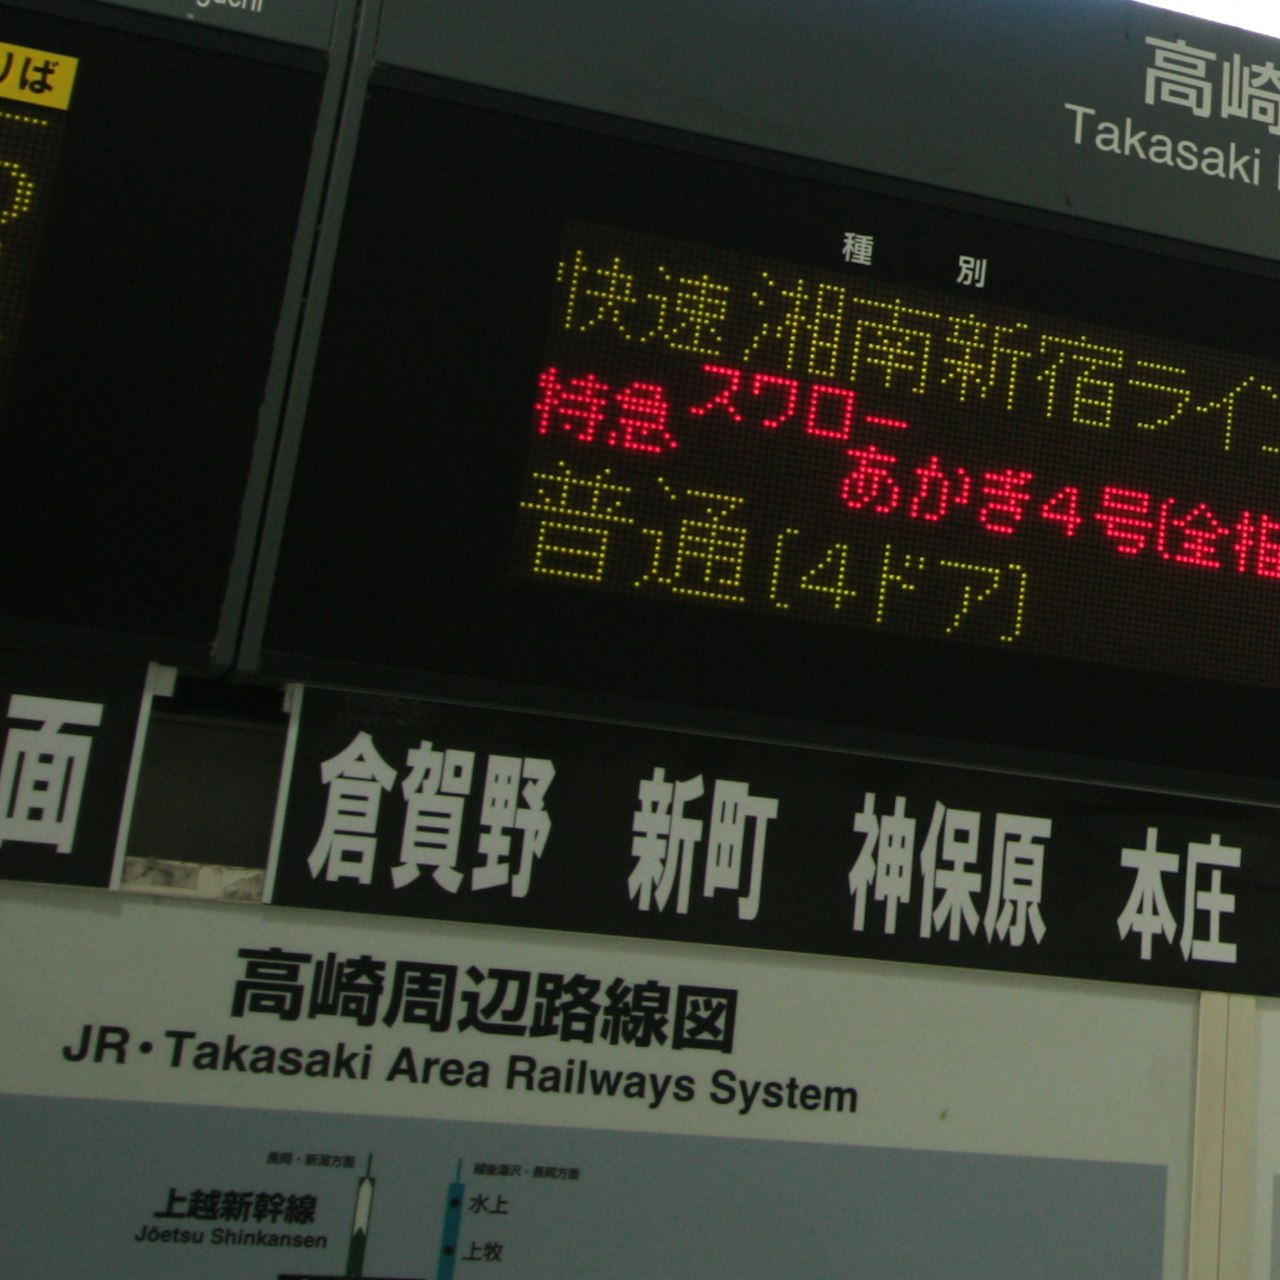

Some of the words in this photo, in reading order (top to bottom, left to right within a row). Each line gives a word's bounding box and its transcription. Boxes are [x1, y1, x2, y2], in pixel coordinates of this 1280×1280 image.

[1063, 102, 1261, 186] Takasaki
[841, 231, 874, 266] 種
[956, 255, 988, 288] 別
[533, 366, 680, 454] 特急
[306, 730, 557, 899] 倉賀野
[626, 766, 779, 921] 新町
[848, 791, 1053, 947] 神保原
[1117, 825, 1242, 964] 本庄
[229, 946, 739, 1055] 高崎周辺路線図
[386, 1046, 491, 1089] Area
[506, 1054, 696, 1110] Railways
[709, 1069, 858, 1115] System
[153, 1187, 318, 1226] 上越新幹線
[210, 1226, 328, 1250] Shinkansen
[468, 1193, 509, 1215] 水上
